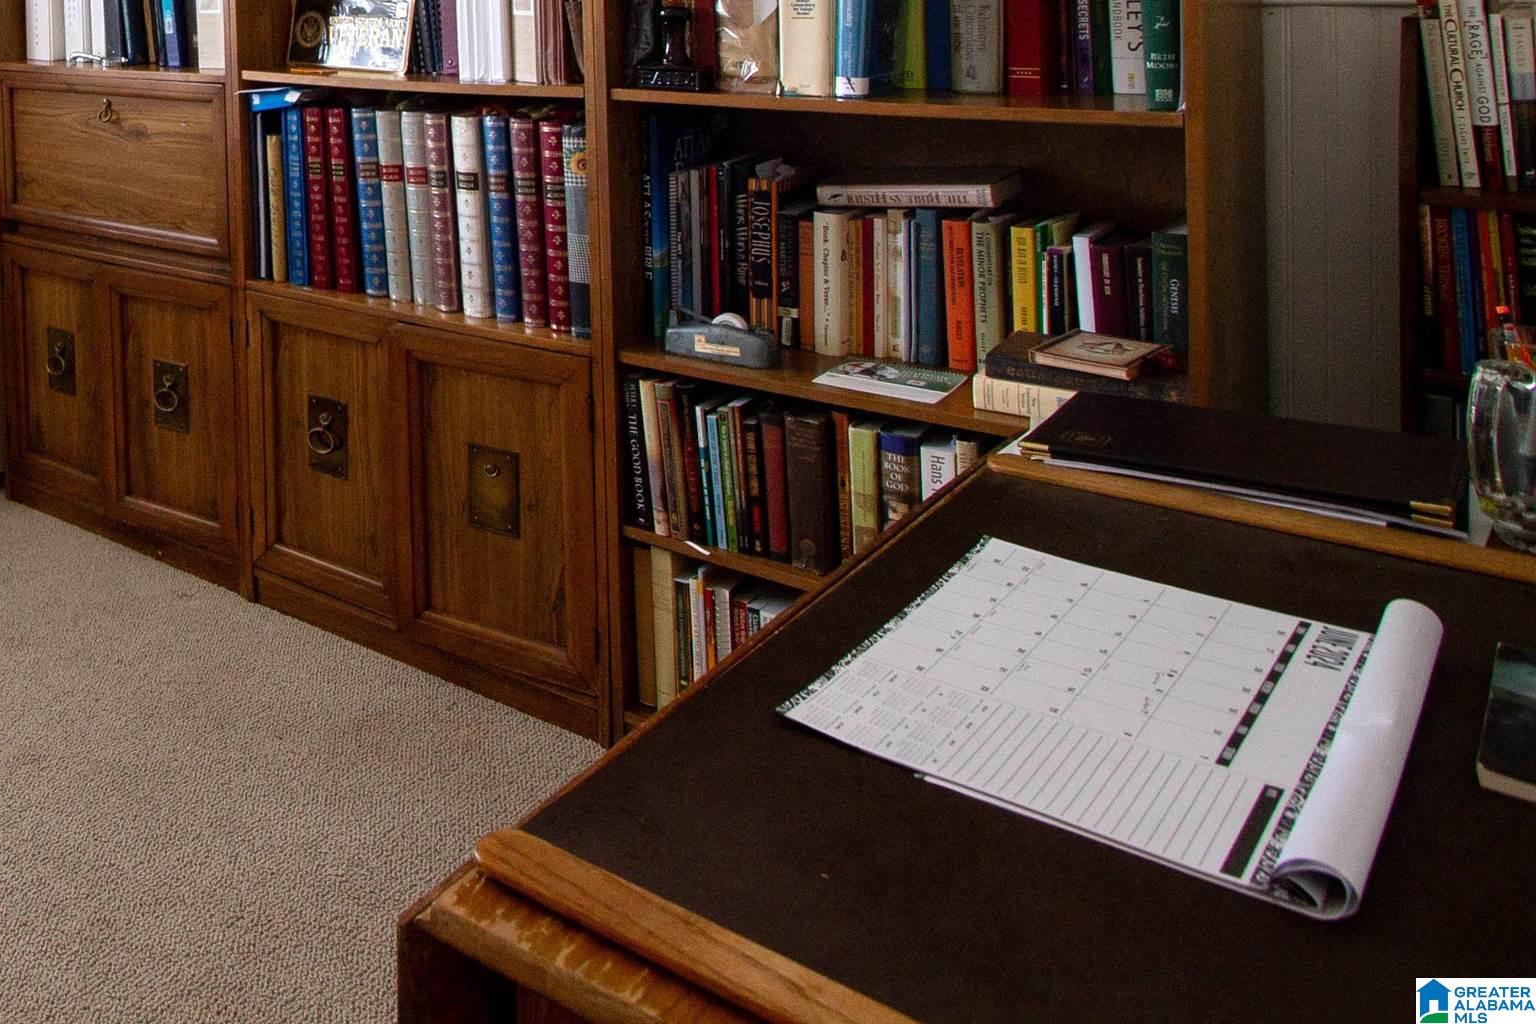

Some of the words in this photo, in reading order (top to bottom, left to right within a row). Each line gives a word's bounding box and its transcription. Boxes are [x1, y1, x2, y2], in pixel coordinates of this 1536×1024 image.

[1076, 0, 1090, 40] SECRETS
[1443, 4, 1453, 19] THE
[329, 26, 406, 48] VETERAN
[1444, 19, 1460, 67] CULTURAL
[1150, 52, 1176, 61] BETH
[1449, 68, 1465, 112] CHURCH
[1475, 62, 1487, 94] AGAINST
[1476, 96, 1492, 124] GOD
[752, 198, 771, 264] JOSEPHUS
[976, 232, 984, 248] THE
[821, 248, 831, 277] Chapter
[977, 250, 986, 278] MINOR
[978, 280, 987, 323] PROPHETS
[1170, 279, 1181, 314] GENESIS
[628, 413, 640, 436] THE
[630, 439, 643, 475] GOOD
[884, 462, 911, 473] BOOK
[888, 453, 906, 463] THE
[931, 455, 945, 485] Hans
[885, 481, 909, 492] GOD
[890, 472, 903, 481] OF
[633, 476, 646, 511] BOOK
[1315, 625, 1360, 650] JUNE
[1304, 644, 1350, 671] 2024
